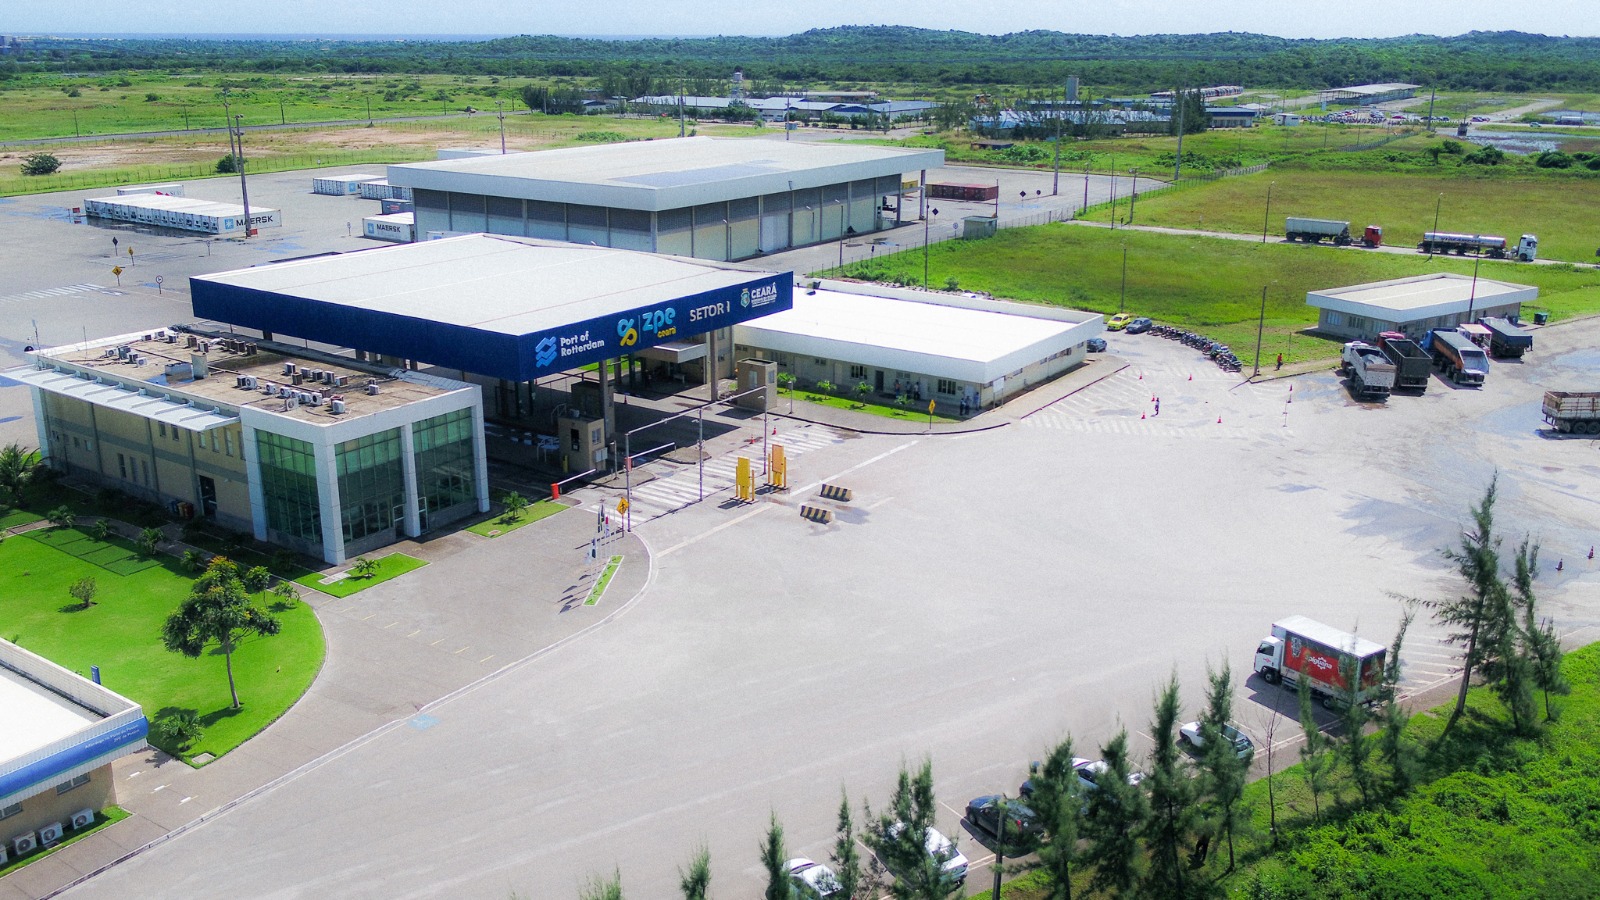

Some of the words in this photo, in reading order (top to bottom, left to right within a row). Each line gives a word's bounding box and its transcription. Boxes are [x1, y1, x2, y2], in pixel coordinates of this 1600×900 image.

[376, 224, 401, 233] MAERSK
[751, 282, 777, 298] CEARÁ
[642, 307, 676, 334] zpe
[690, 303, 724, 322] SETOR
[560, 334, 579, 347] Port
[580, 331, 589, 342] of
[561, 340, 605, 357] Rotterdam
